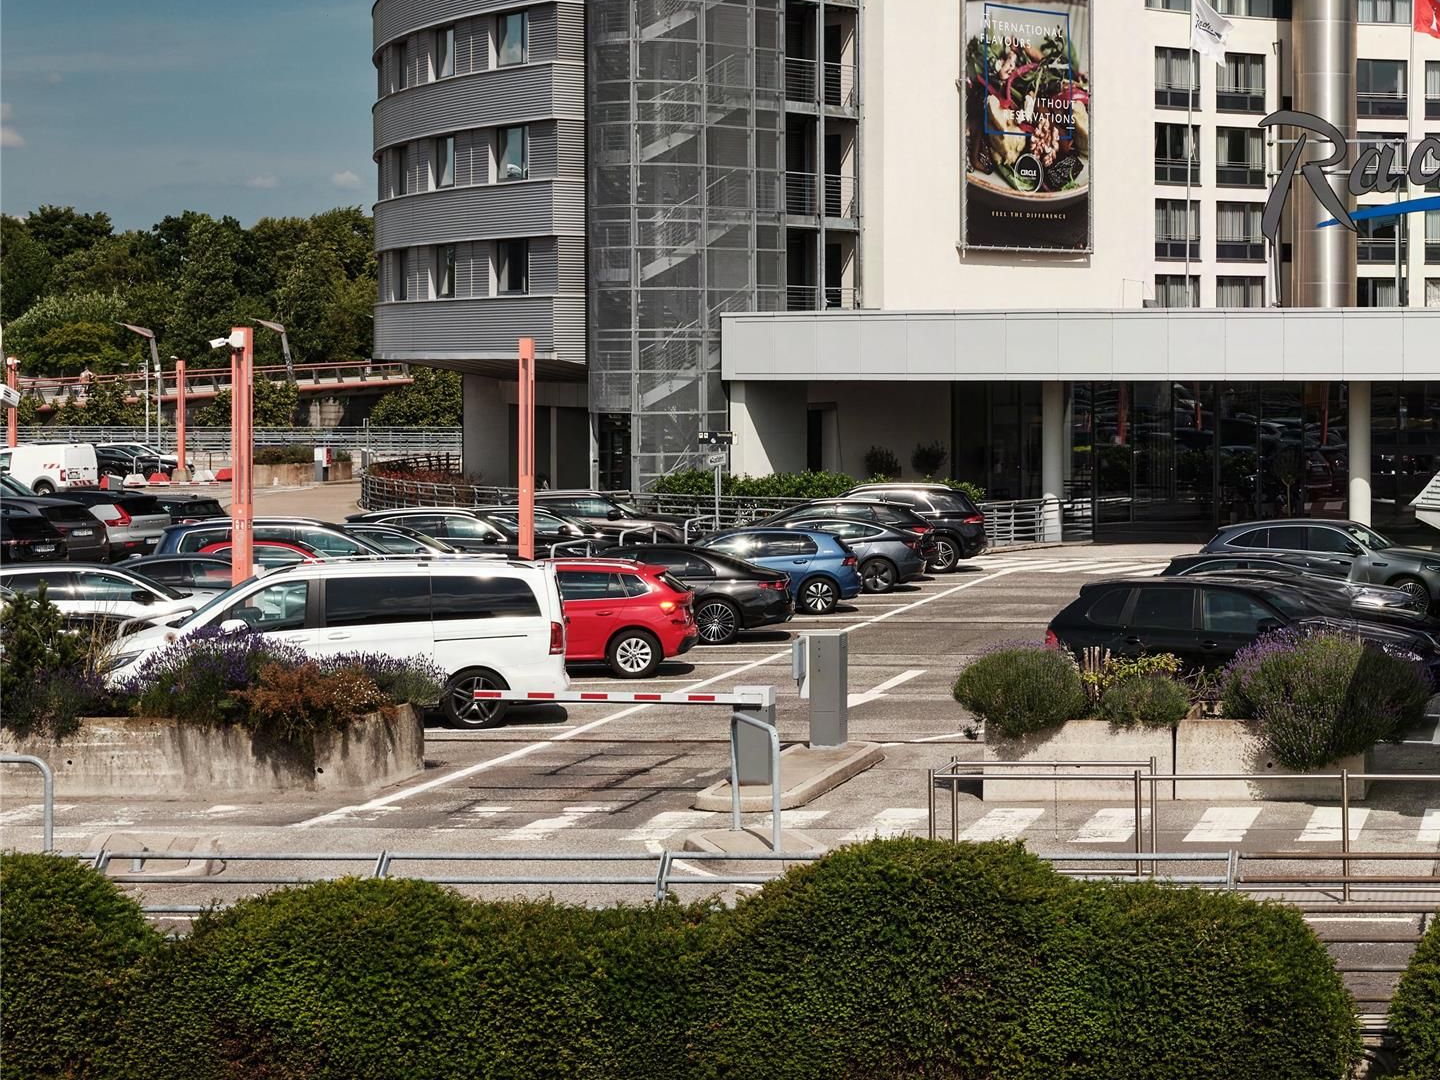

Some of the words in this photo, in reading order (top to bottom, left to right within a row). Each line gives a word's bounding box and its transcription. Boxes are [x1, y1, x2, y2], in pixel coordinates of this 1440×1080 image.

[979, 19, 1063, 38] INTERNATIONAL
[979, 33, 1032, 49] FLAVOURS
[1029, 97, 1077, 110] ITHOUT
[1026, 212, 1066, 220] DIFFERENCE
